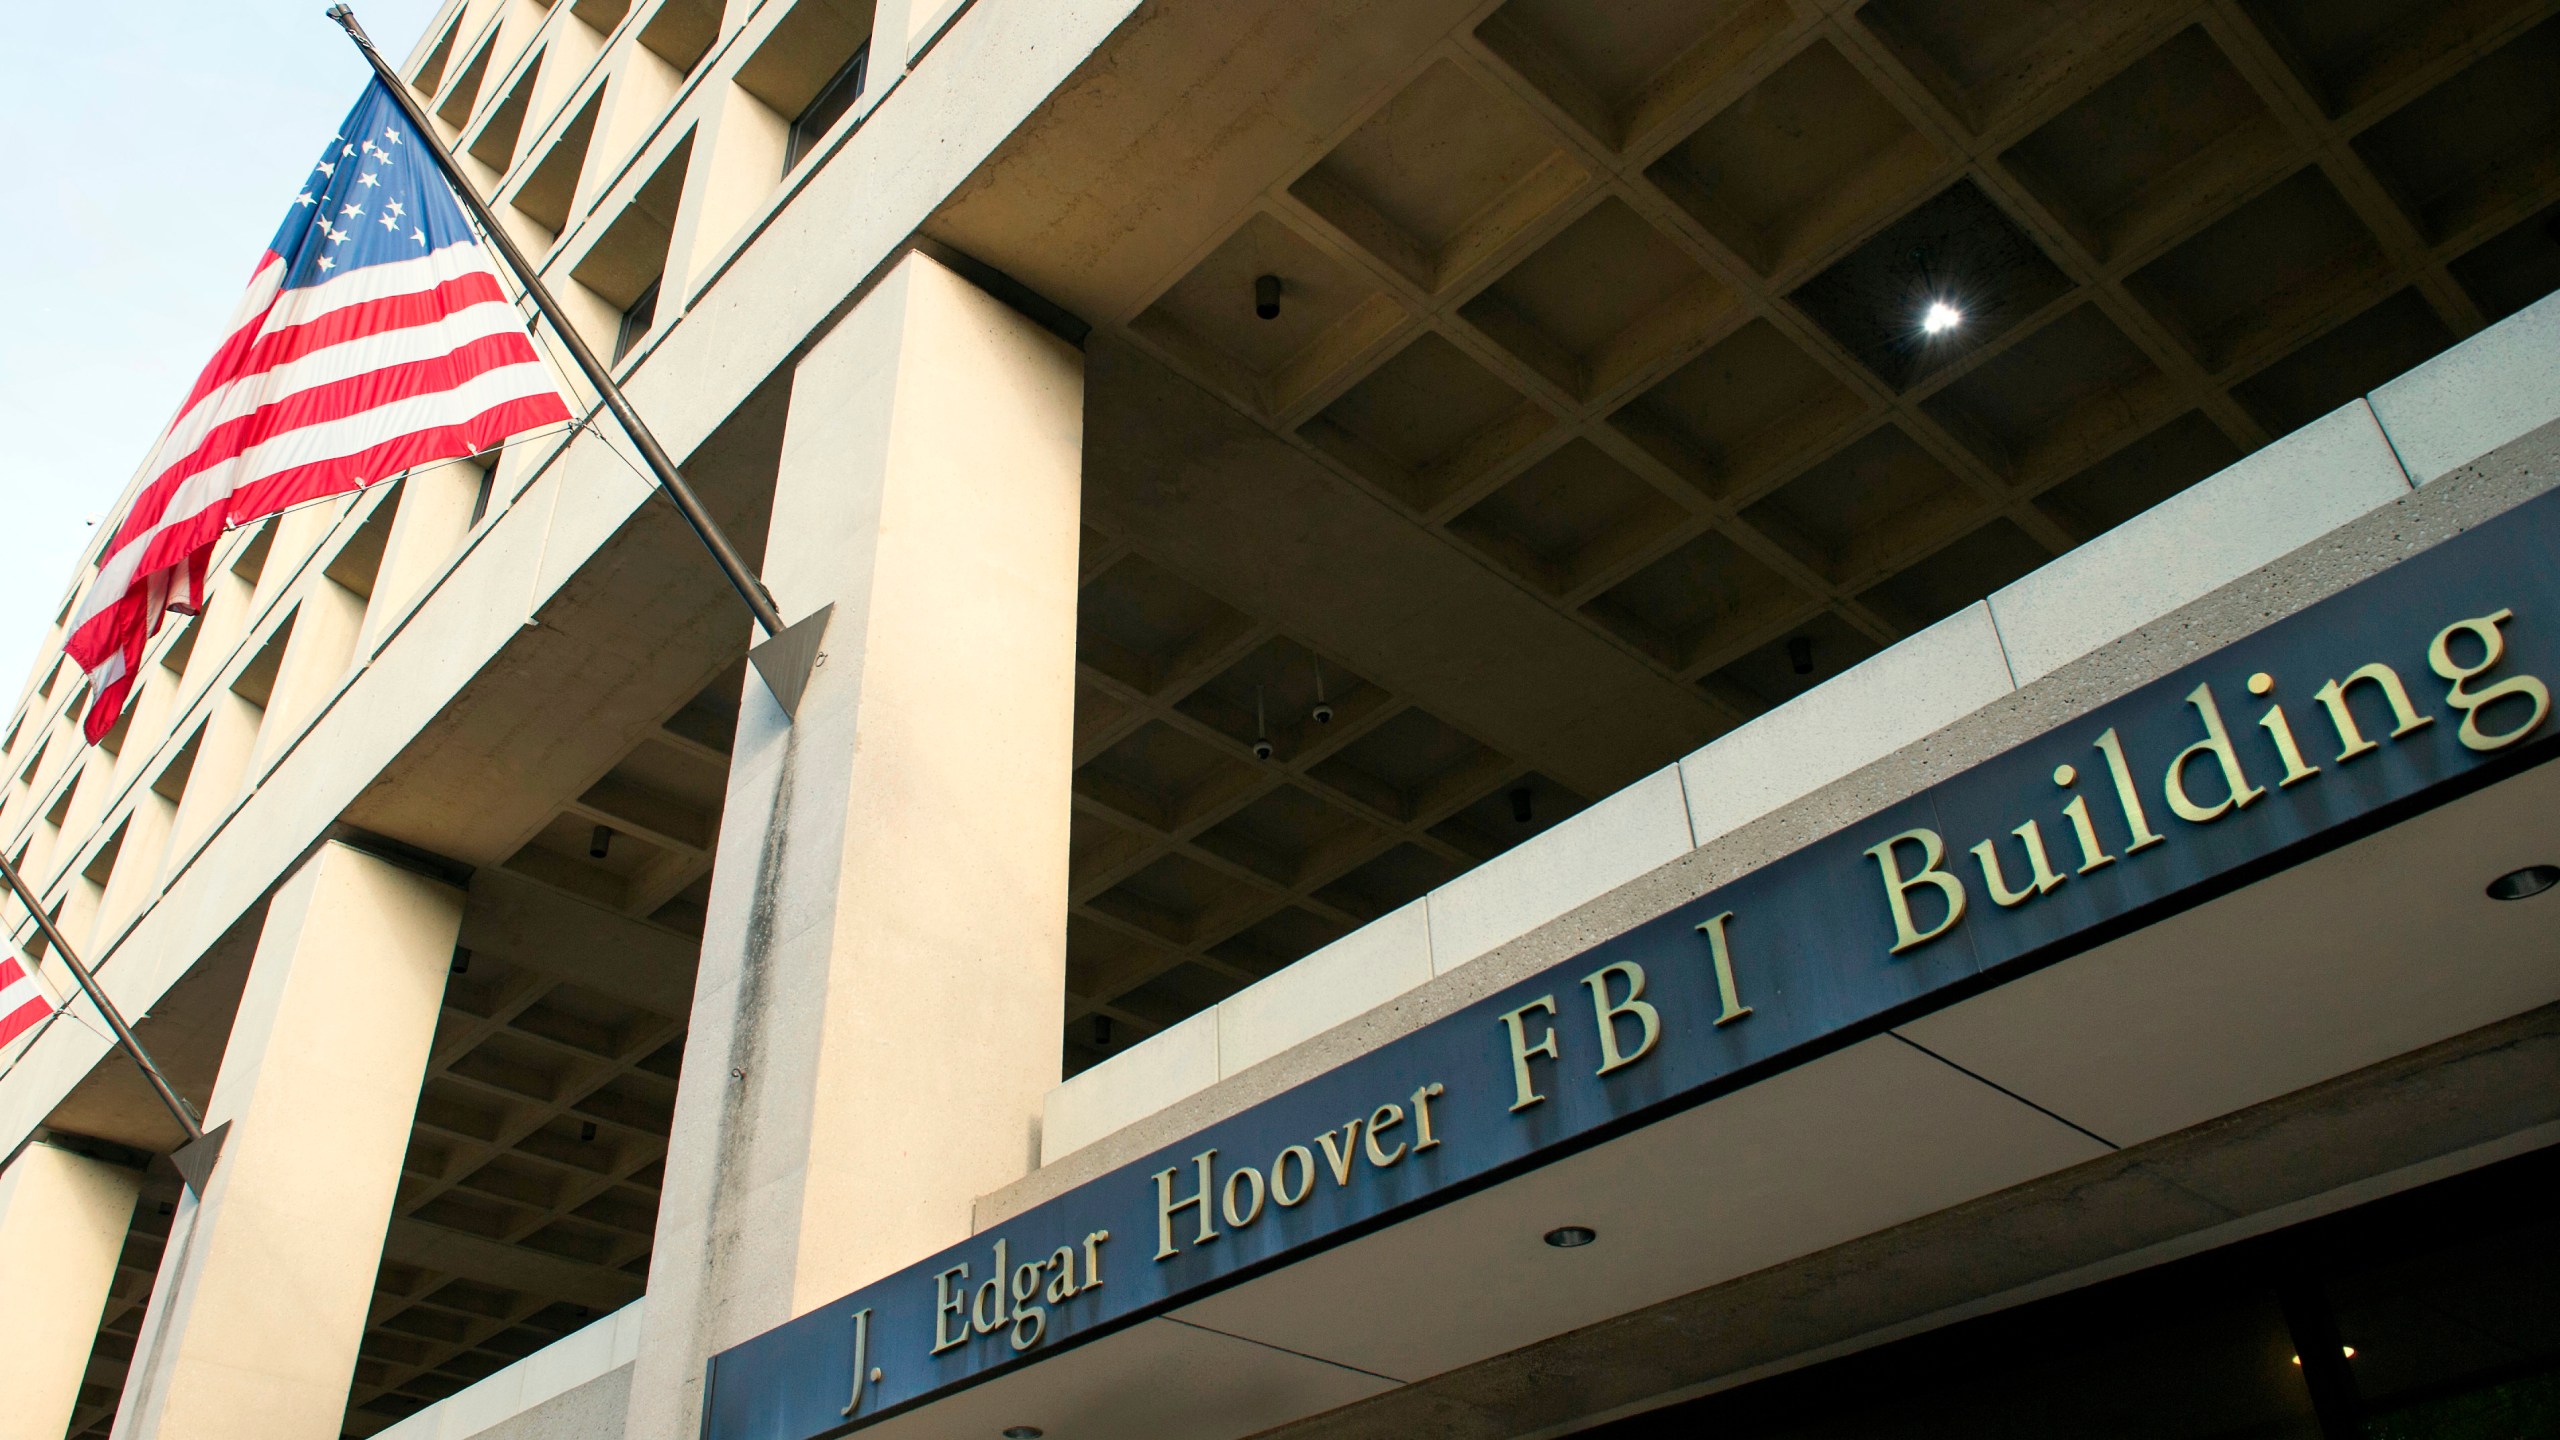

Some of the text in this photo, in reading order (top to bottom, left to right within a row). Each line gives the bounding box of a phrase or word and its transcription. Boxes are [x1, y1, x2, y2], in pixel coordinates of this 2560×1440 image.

[841, 607, 2551, 1416] J. Edgar Hoover FBI Building
